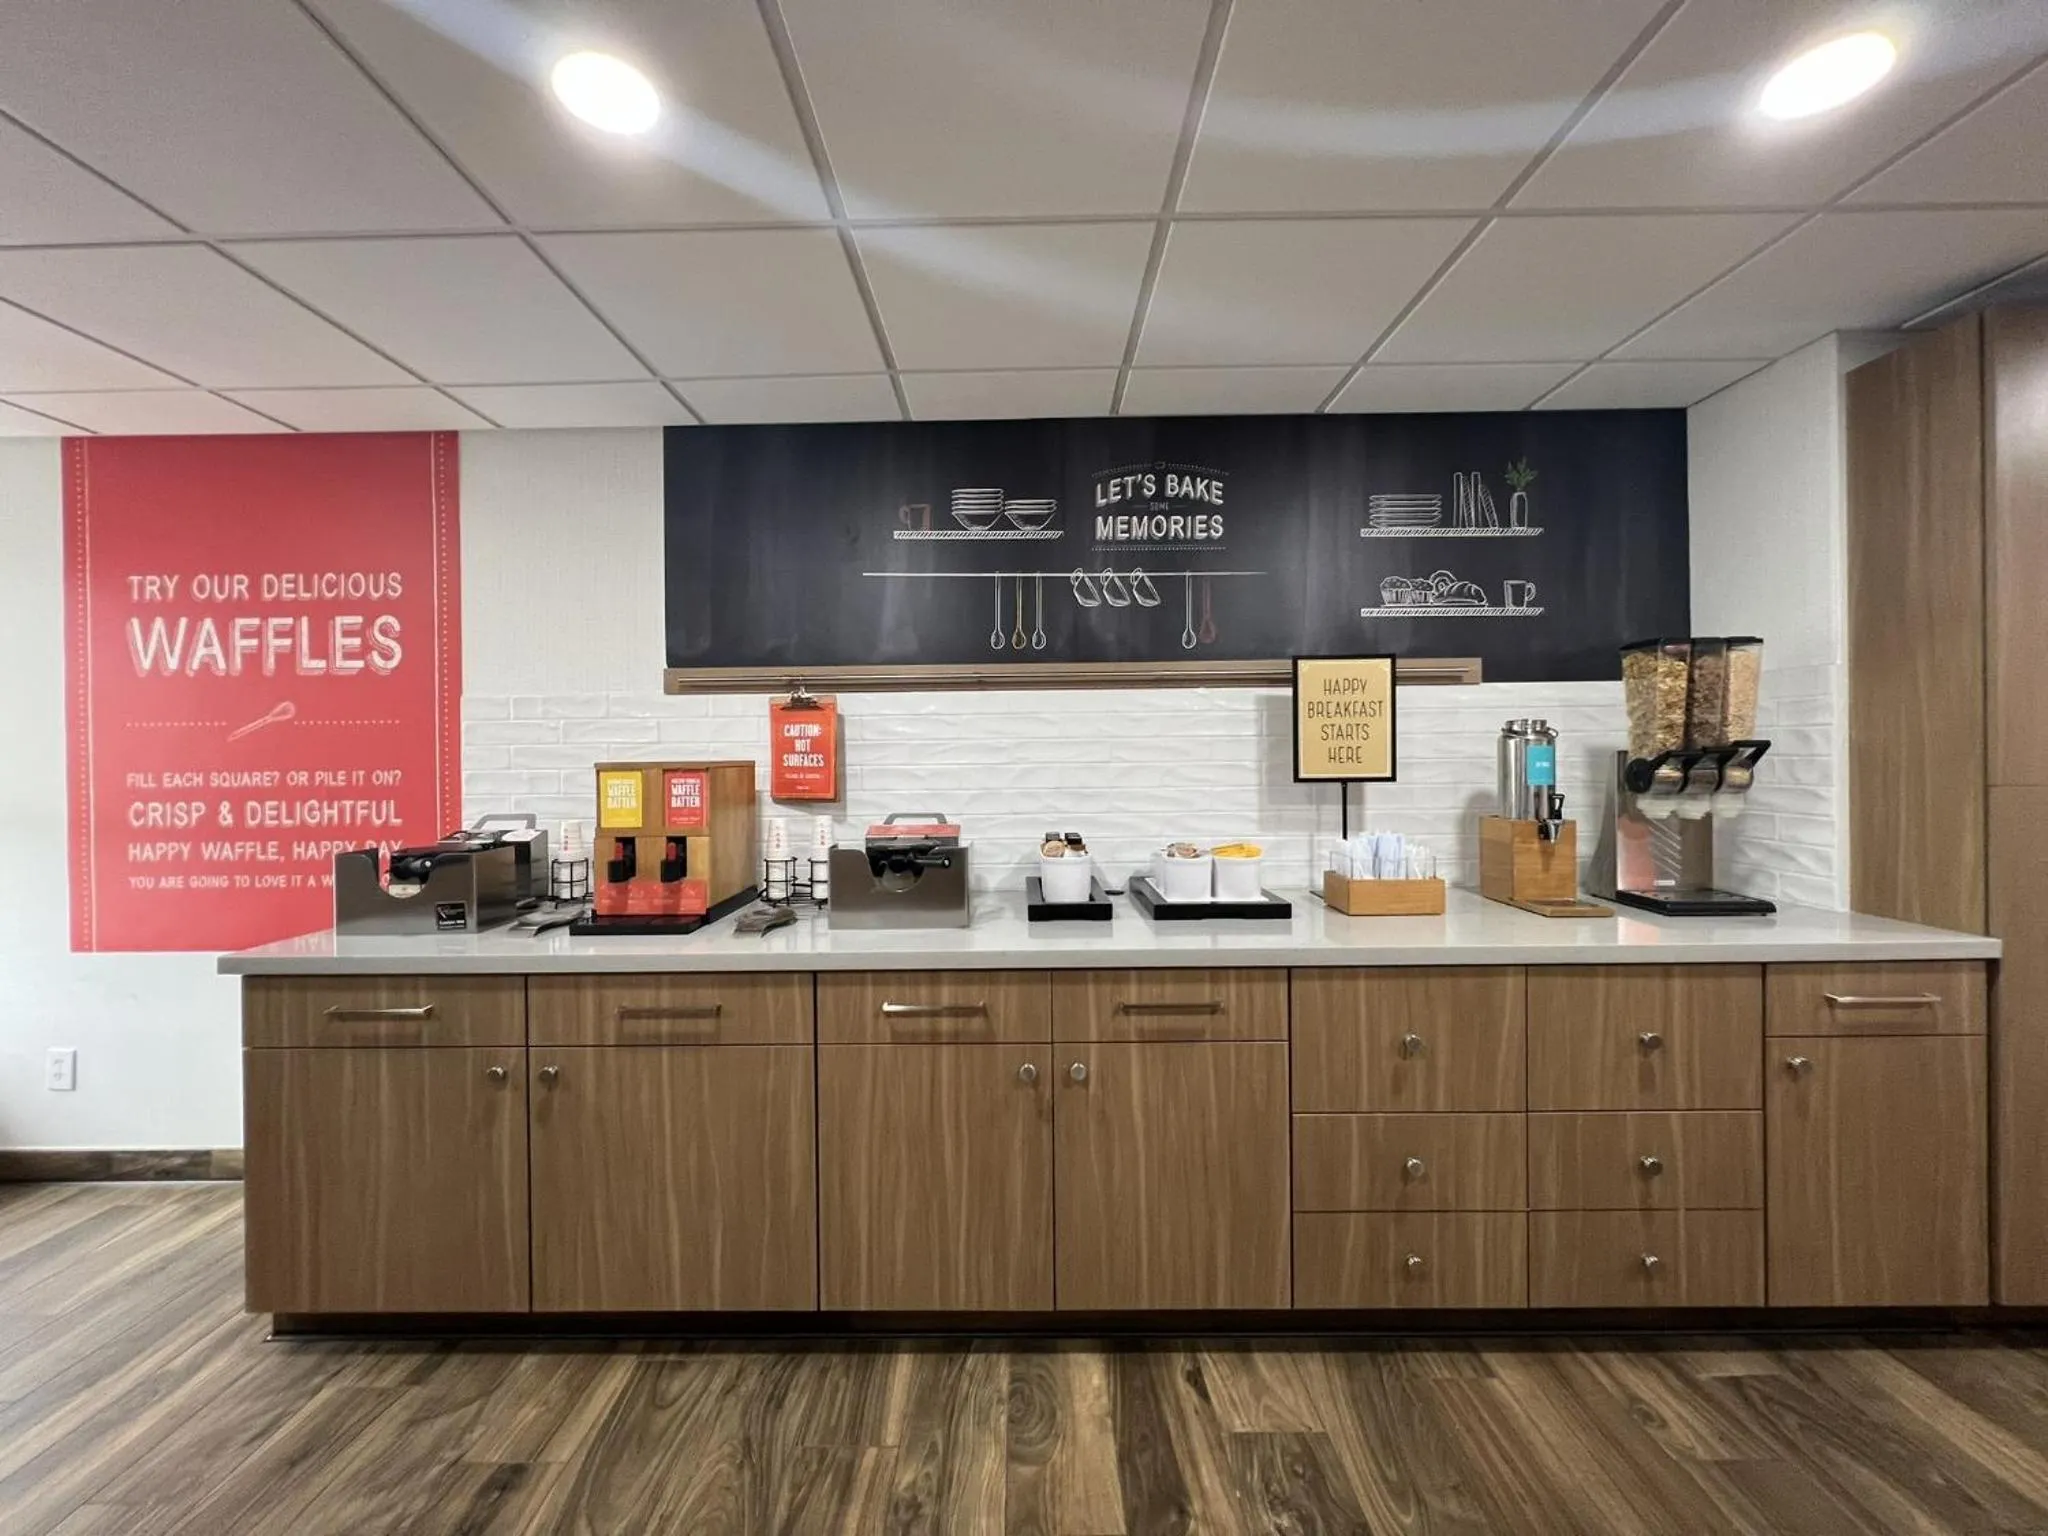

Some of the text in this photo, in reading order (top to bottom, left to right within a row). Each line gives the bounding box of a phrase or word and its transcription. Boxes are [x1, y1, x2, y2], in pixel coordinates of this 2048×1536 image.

[1095, 473, 1224, 507] LET'S BAKE
[1150, 502, 1169, 511] SOME
[1095, 515, 1224, 541] MEMORIES
[128, 572, 403, 602] TRY OUR DELICIOUS
[126, 615, 402, 677] WAFFLES
[1323, 678, 1367, 695] HAPPY
[1307, 700, 1383, 718] BREAKFAST
[1321, 723, 1370, 741] STARTS
[794, 739, 811, 752] HOT
[783, 753, 825, 767] SURFACES
[1328, 746, 1363, 764] HERE
[126, 769, 402, 788] FILL EACH SQUARE? OR PILE IT ON?
[608, 784, 636, 796] WAFFLE
[671, 784, 700, 795] WAFFLE
[607, 797, 637, 808] BATTER
[671, 796, 700, 808] BATTER
[128, 800, 403, 827] CRISP & DELIGHTFUL
[127, 842, 191, 861] HAPPY
[201, 841, 285, 863] WAFFLE,
[292, 840, 357, 860] HAPPY
[129, 876, 154, 889] YOU
[159, 875, 184, 888] ARE
[189, 875, 229, 888] GOING
[234, 875, 250, 888] TO
[255, 875, 286, 888] LOVE
[291, 874, 304, 887] IT
[307, 874, 317, 888] A
